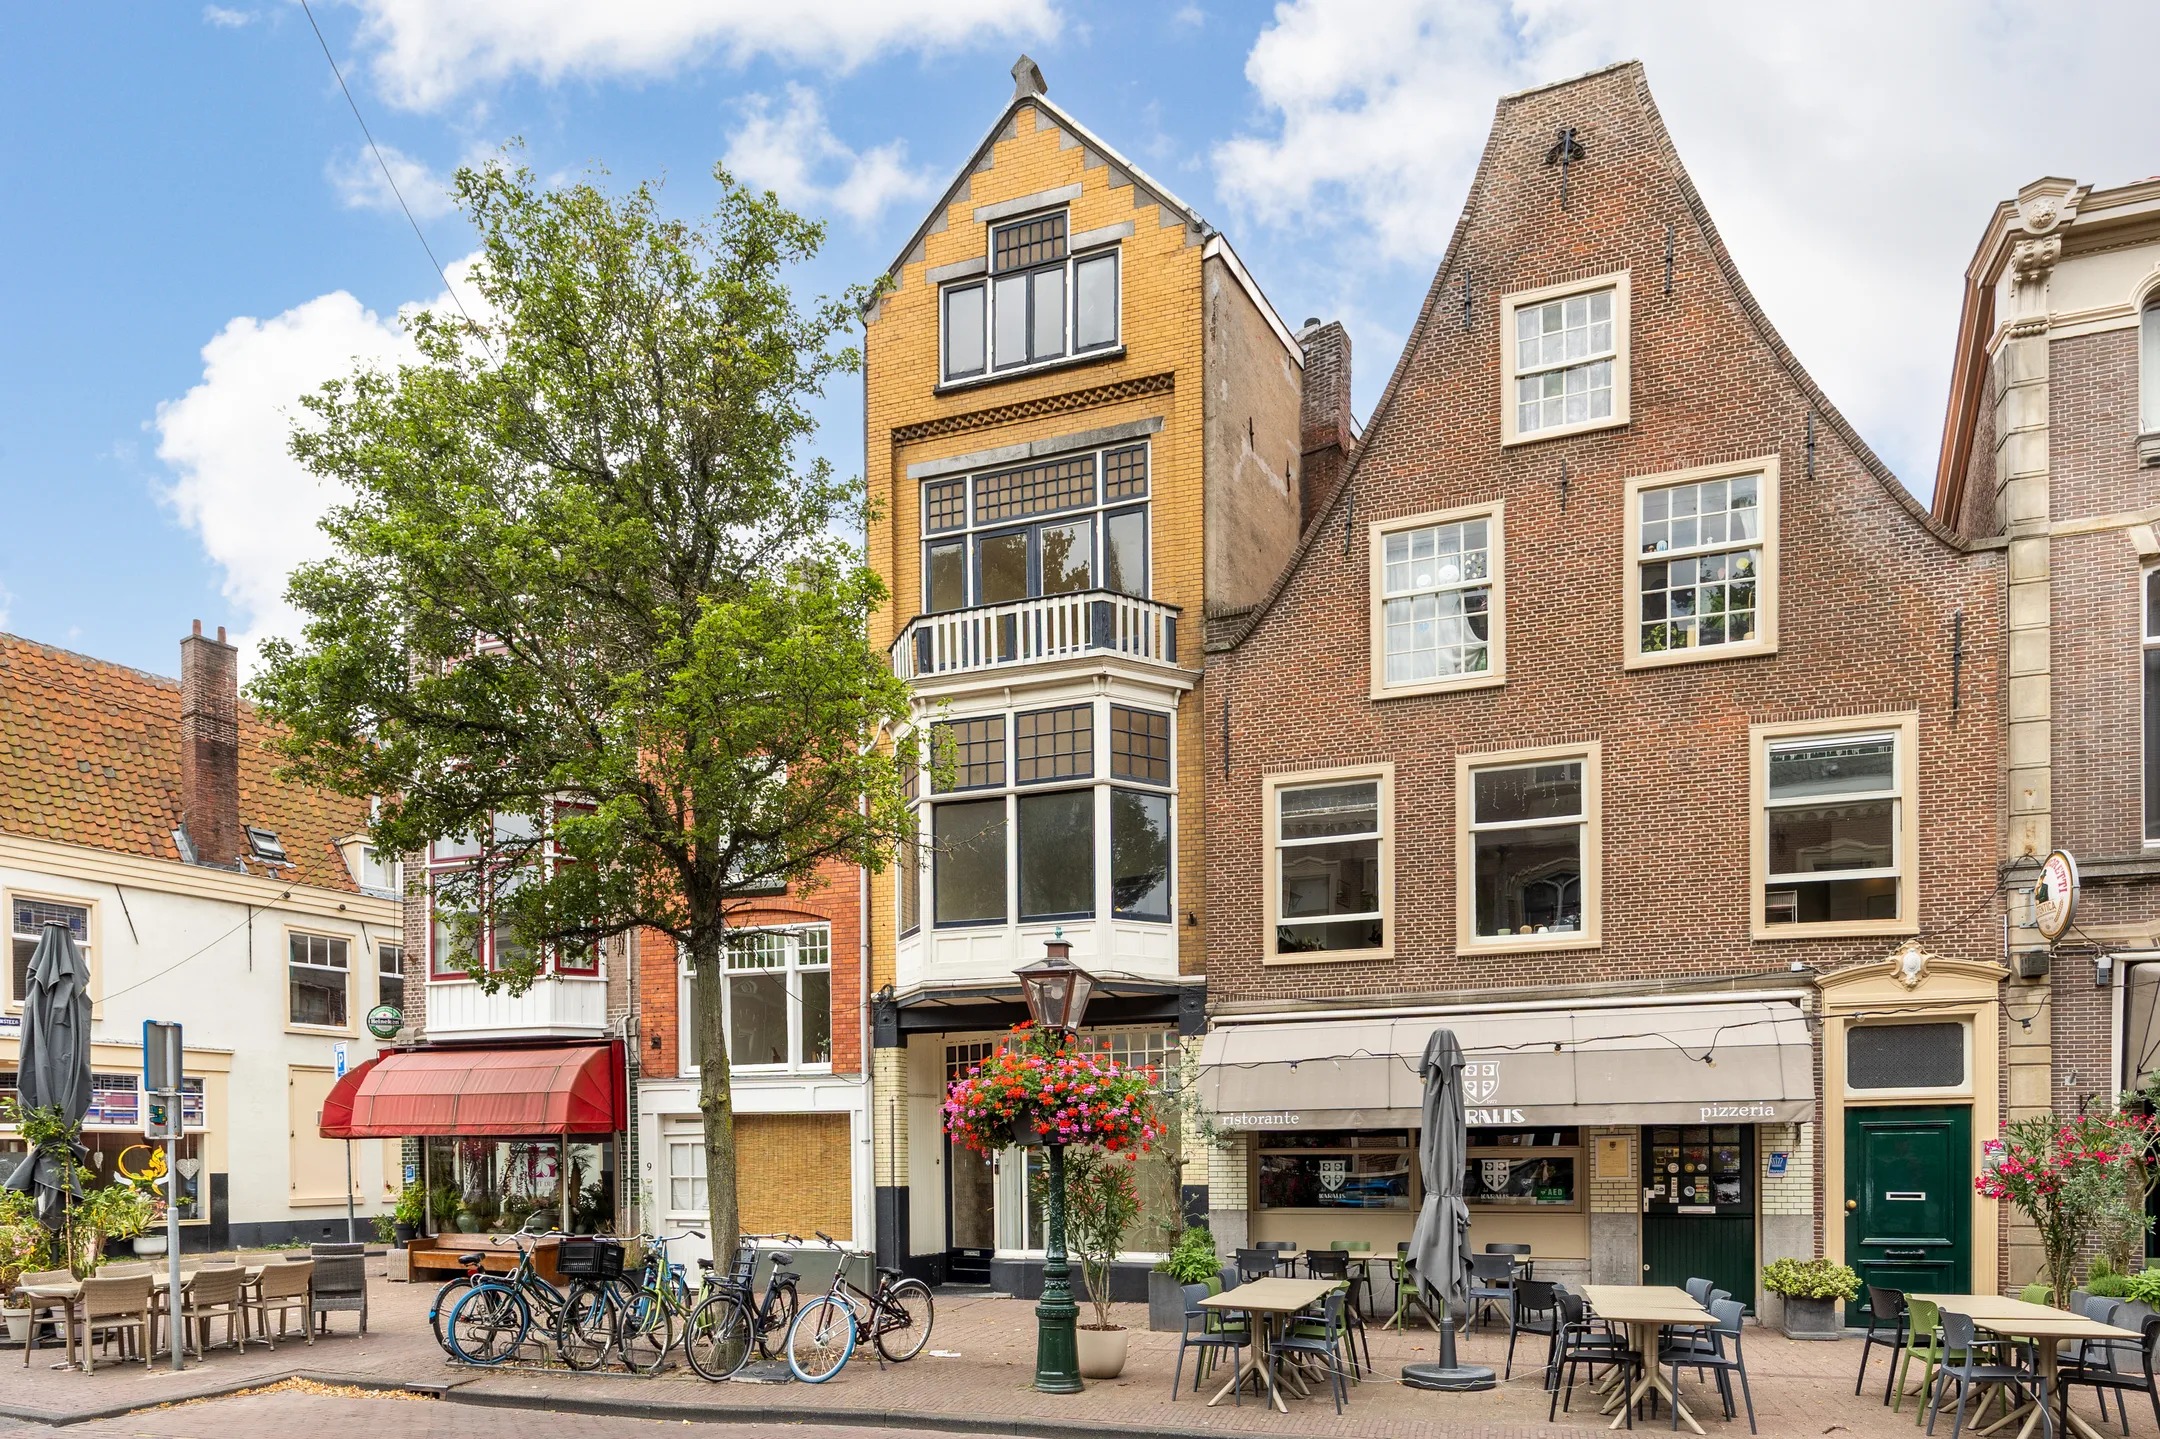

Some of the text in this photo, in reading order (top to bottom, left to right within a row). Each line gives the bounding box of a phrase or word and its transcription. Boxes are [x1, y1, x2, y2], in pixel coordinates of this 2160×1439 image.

[338, 1052, 344, 1068] P
[1221, 1111, 1300, 1126] ristorante
[1464, 1108, 1526, 1125] RALIS
[1699, 1101, 1776, 1123] pizzeria
[646, 1162, 652, 1171] 9
[1547, 1188, 1563, 1196] AED
